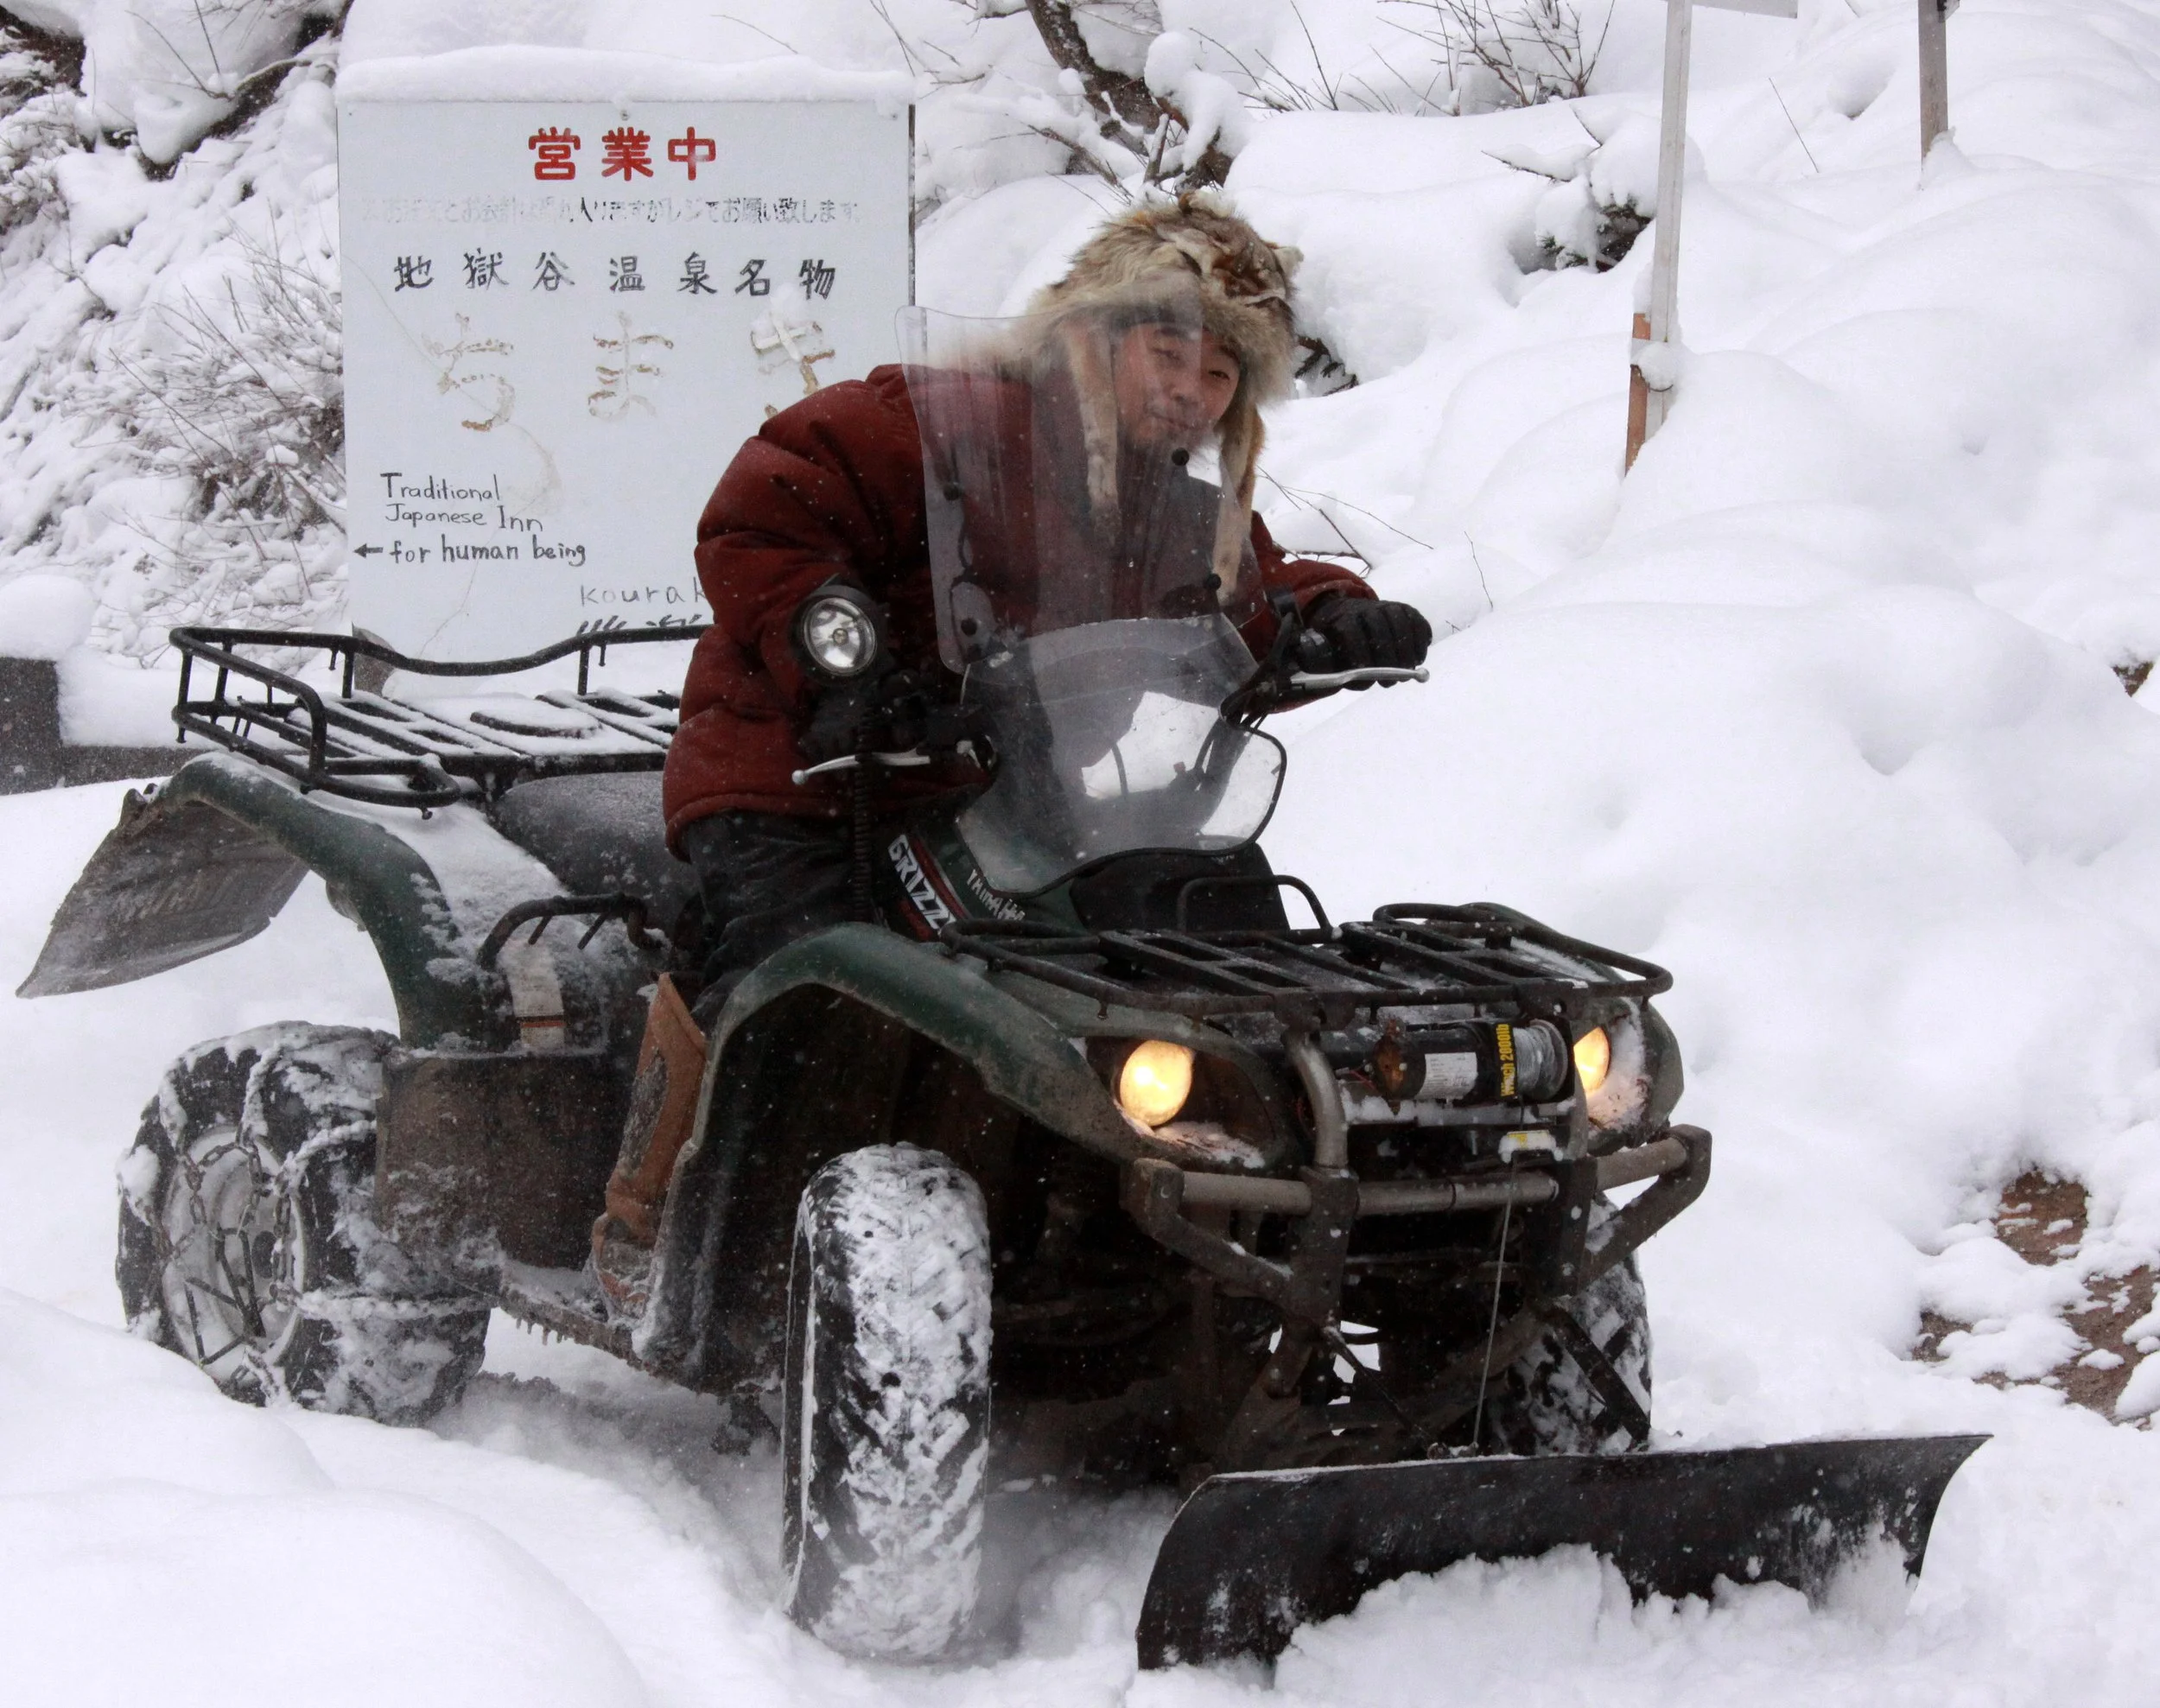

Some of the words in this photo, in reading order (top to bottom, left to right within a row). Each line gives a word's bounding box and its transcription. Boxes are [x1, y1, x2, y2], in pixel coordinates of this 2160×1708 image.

[528, 126, 716, 181] 営業中
[394, 247, 836, 301] 地獄谷温泉名物
[380, 473, 499, 502] Traditional
[385, 503, 486, 528] Japanese
[498, 505, 543, 532] Inn
[389, 540, 430, 563] for
[442, 534, 518, 562] human
[531, 534, 586, 567] being
[887, 834, 957, 931] GRIZZ
